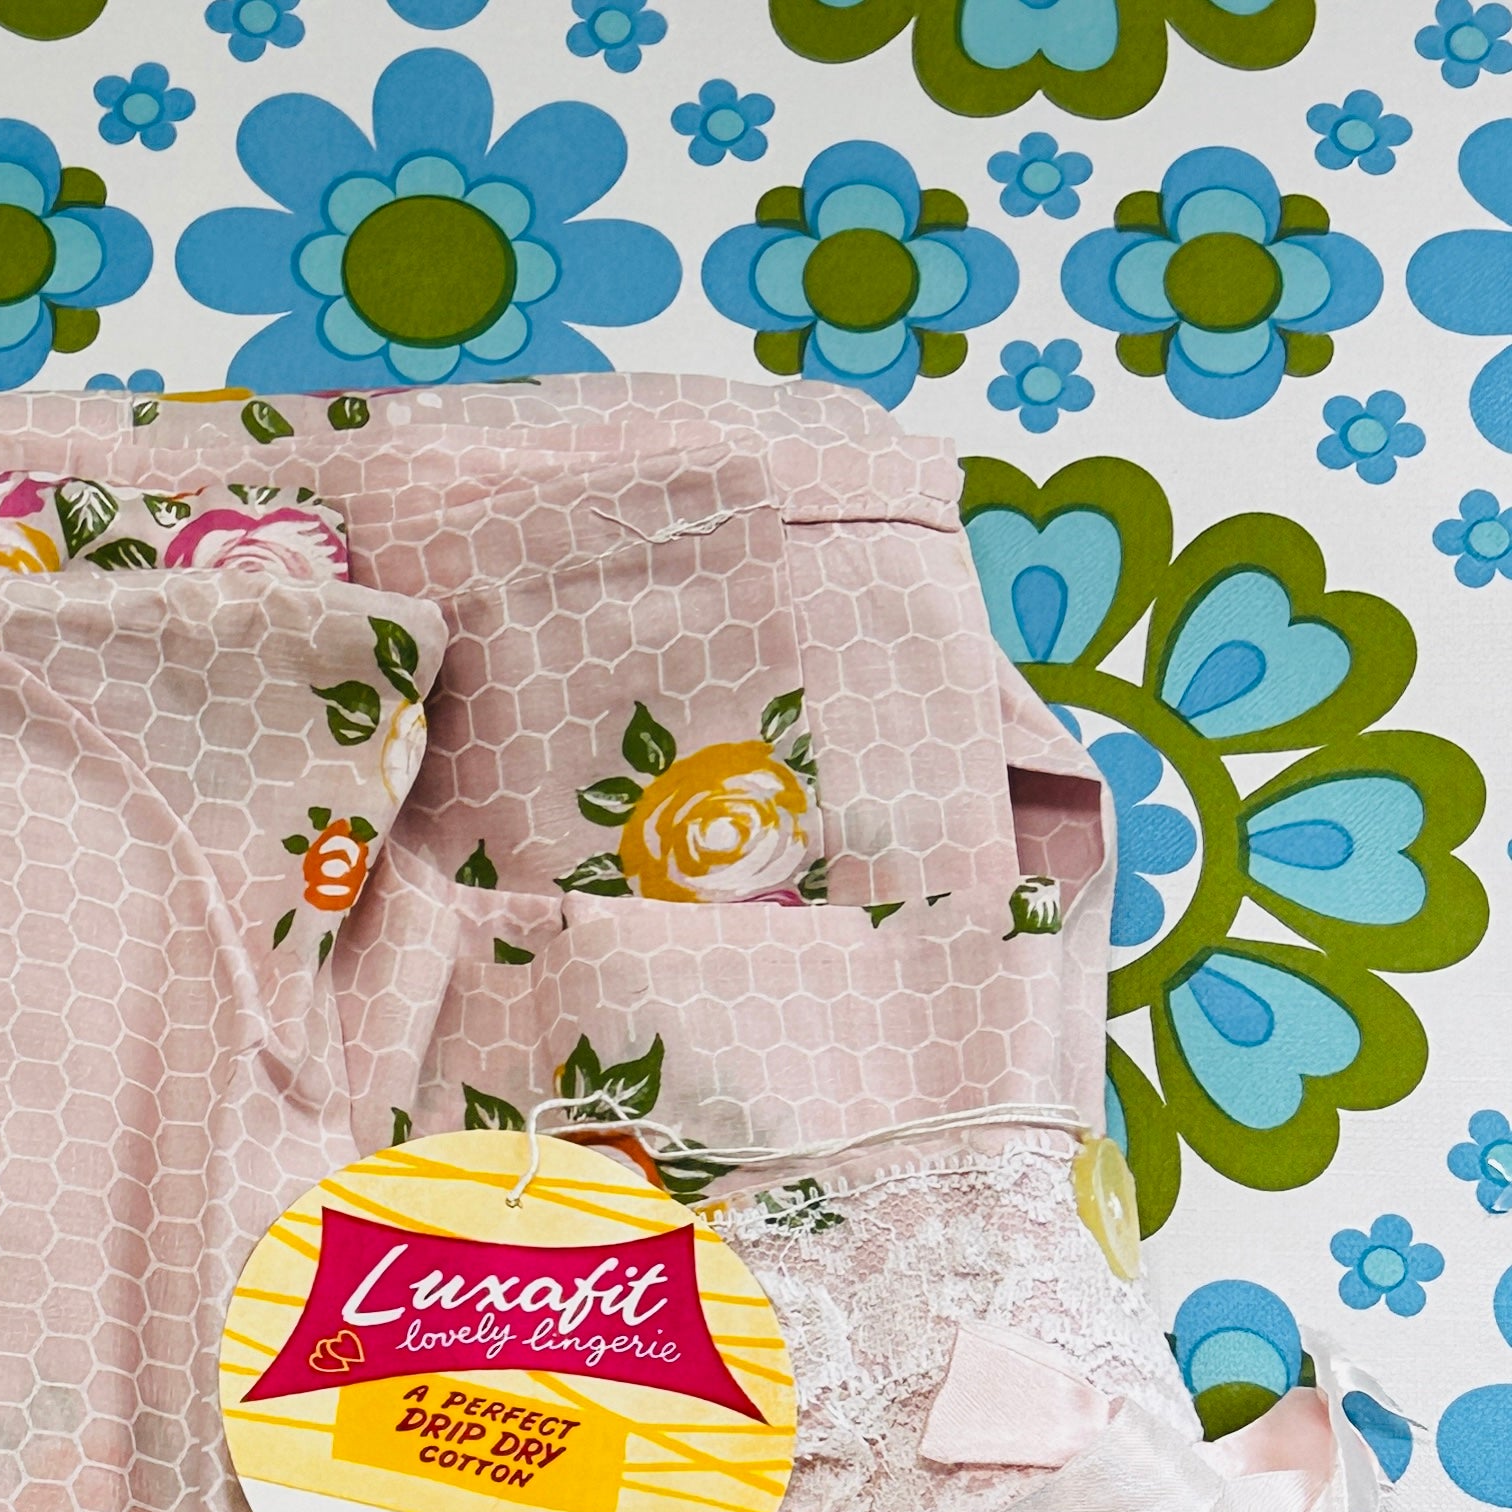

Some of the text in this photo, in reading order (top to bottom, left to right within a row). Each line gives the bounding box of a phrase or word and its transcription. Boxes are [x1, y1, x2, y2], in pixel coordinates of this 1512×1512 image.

[342, 1244, 668, 1334] Luxafit
[396, 1313, 682, 1367] lovely lingerie
[395, 1408, 567, 1469] DRIP DRY
[402, 1385, 581, 1439] A PERFECT
[419, 1445, 534, 1488] COTTON
